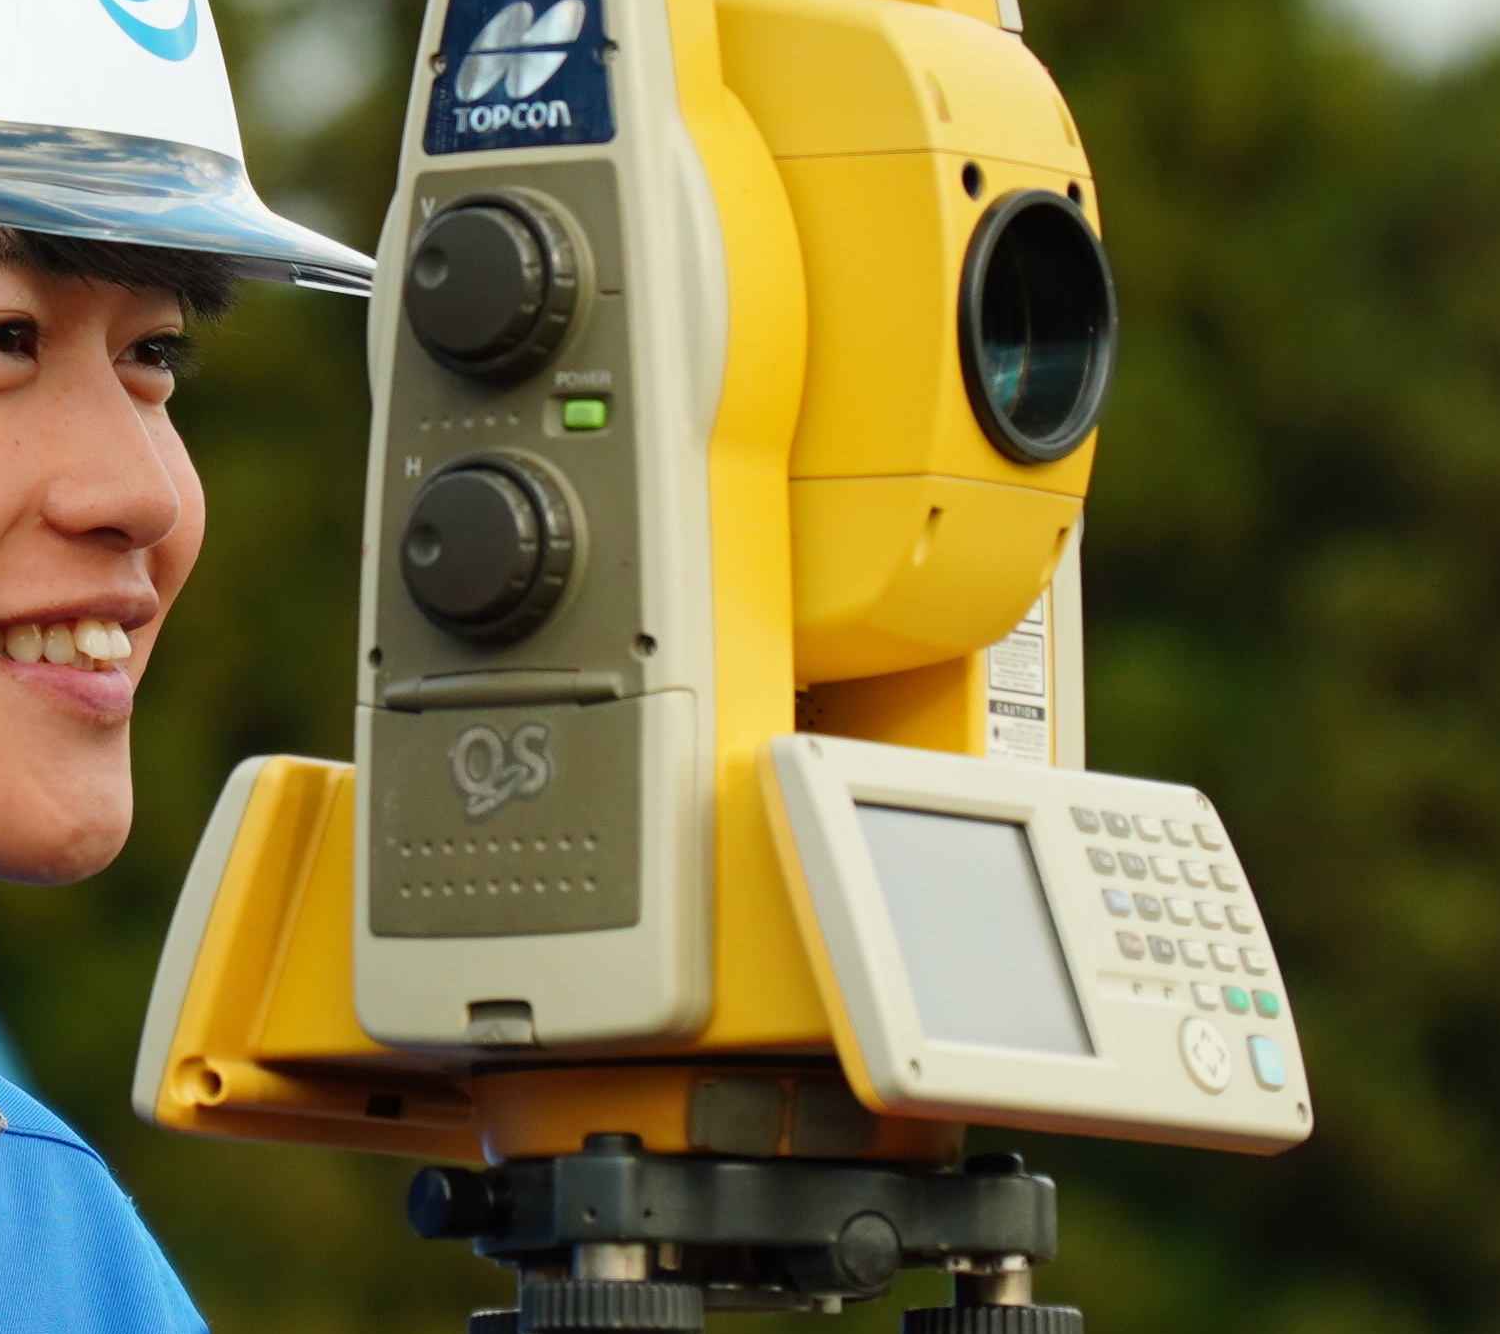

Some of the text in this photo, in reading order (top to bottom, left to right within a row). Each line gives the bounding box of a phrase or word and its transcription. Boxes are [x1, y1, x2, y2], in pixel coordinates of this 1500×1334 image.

[453, 99, 572, 134] TOPCON
[420, 198, 437, 218] V
[554, 370, 613, 387] POWER
[405, 456, 422, 478] H
[995, 702, 1039, 719] CAUTION
[451, 722, 553, 820] QS
